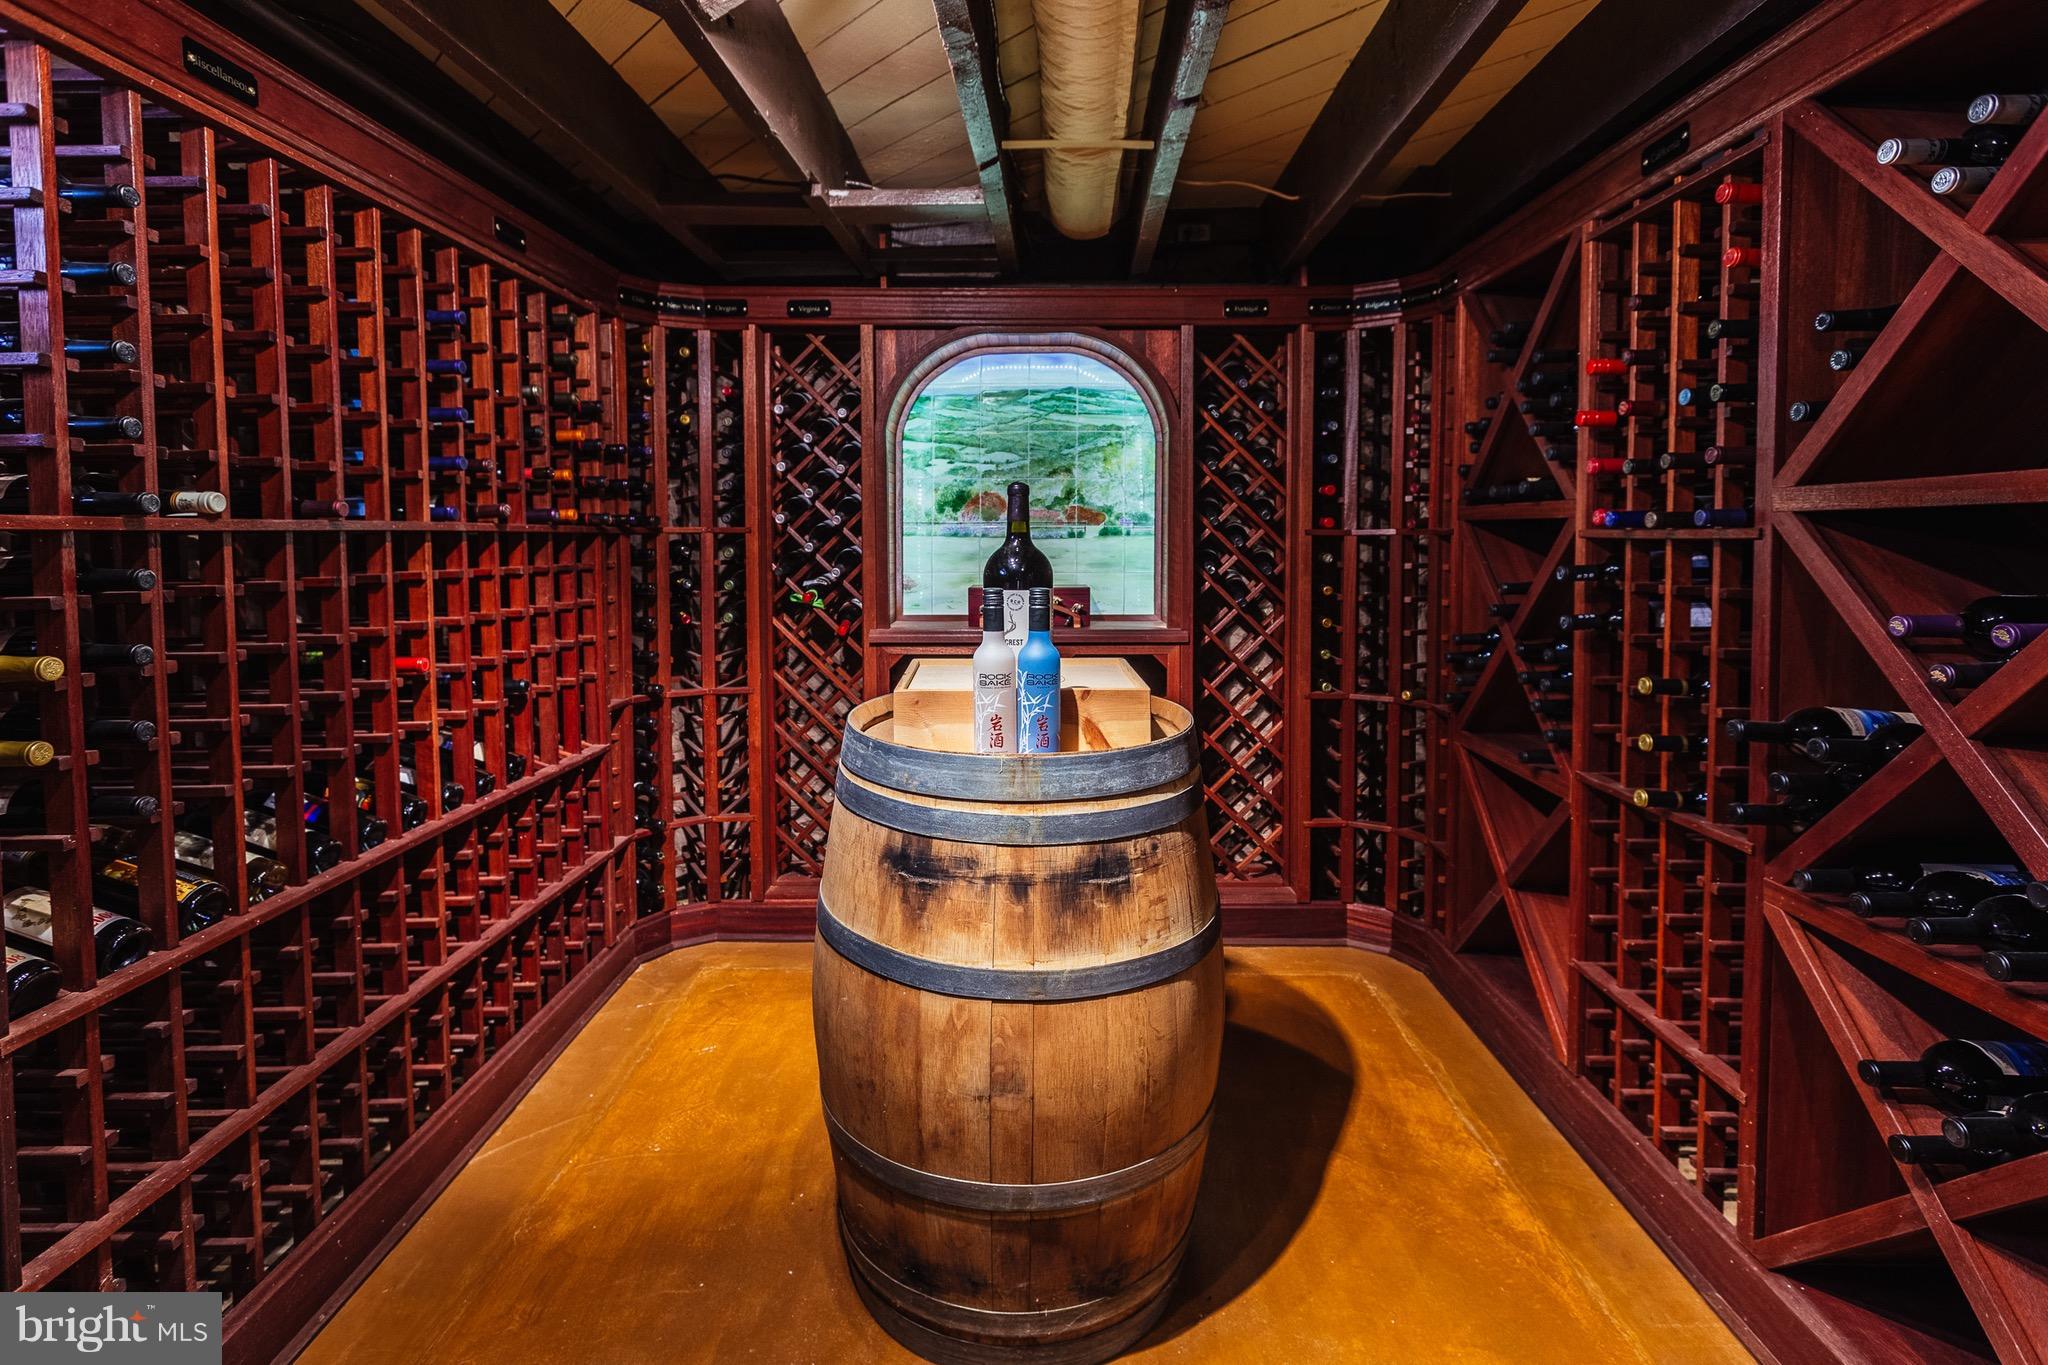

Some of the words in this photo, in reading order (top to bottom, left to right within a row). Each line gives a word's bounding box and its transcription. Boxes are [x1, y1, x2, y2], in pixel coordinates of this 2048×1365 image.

[191, 54, 253, 95] iscellaneou
[798, 304, 821, 313] Virginia
[988, 713, 1004, 749] 岩酒
[1036, 714, 1050, 749] 岩酒
